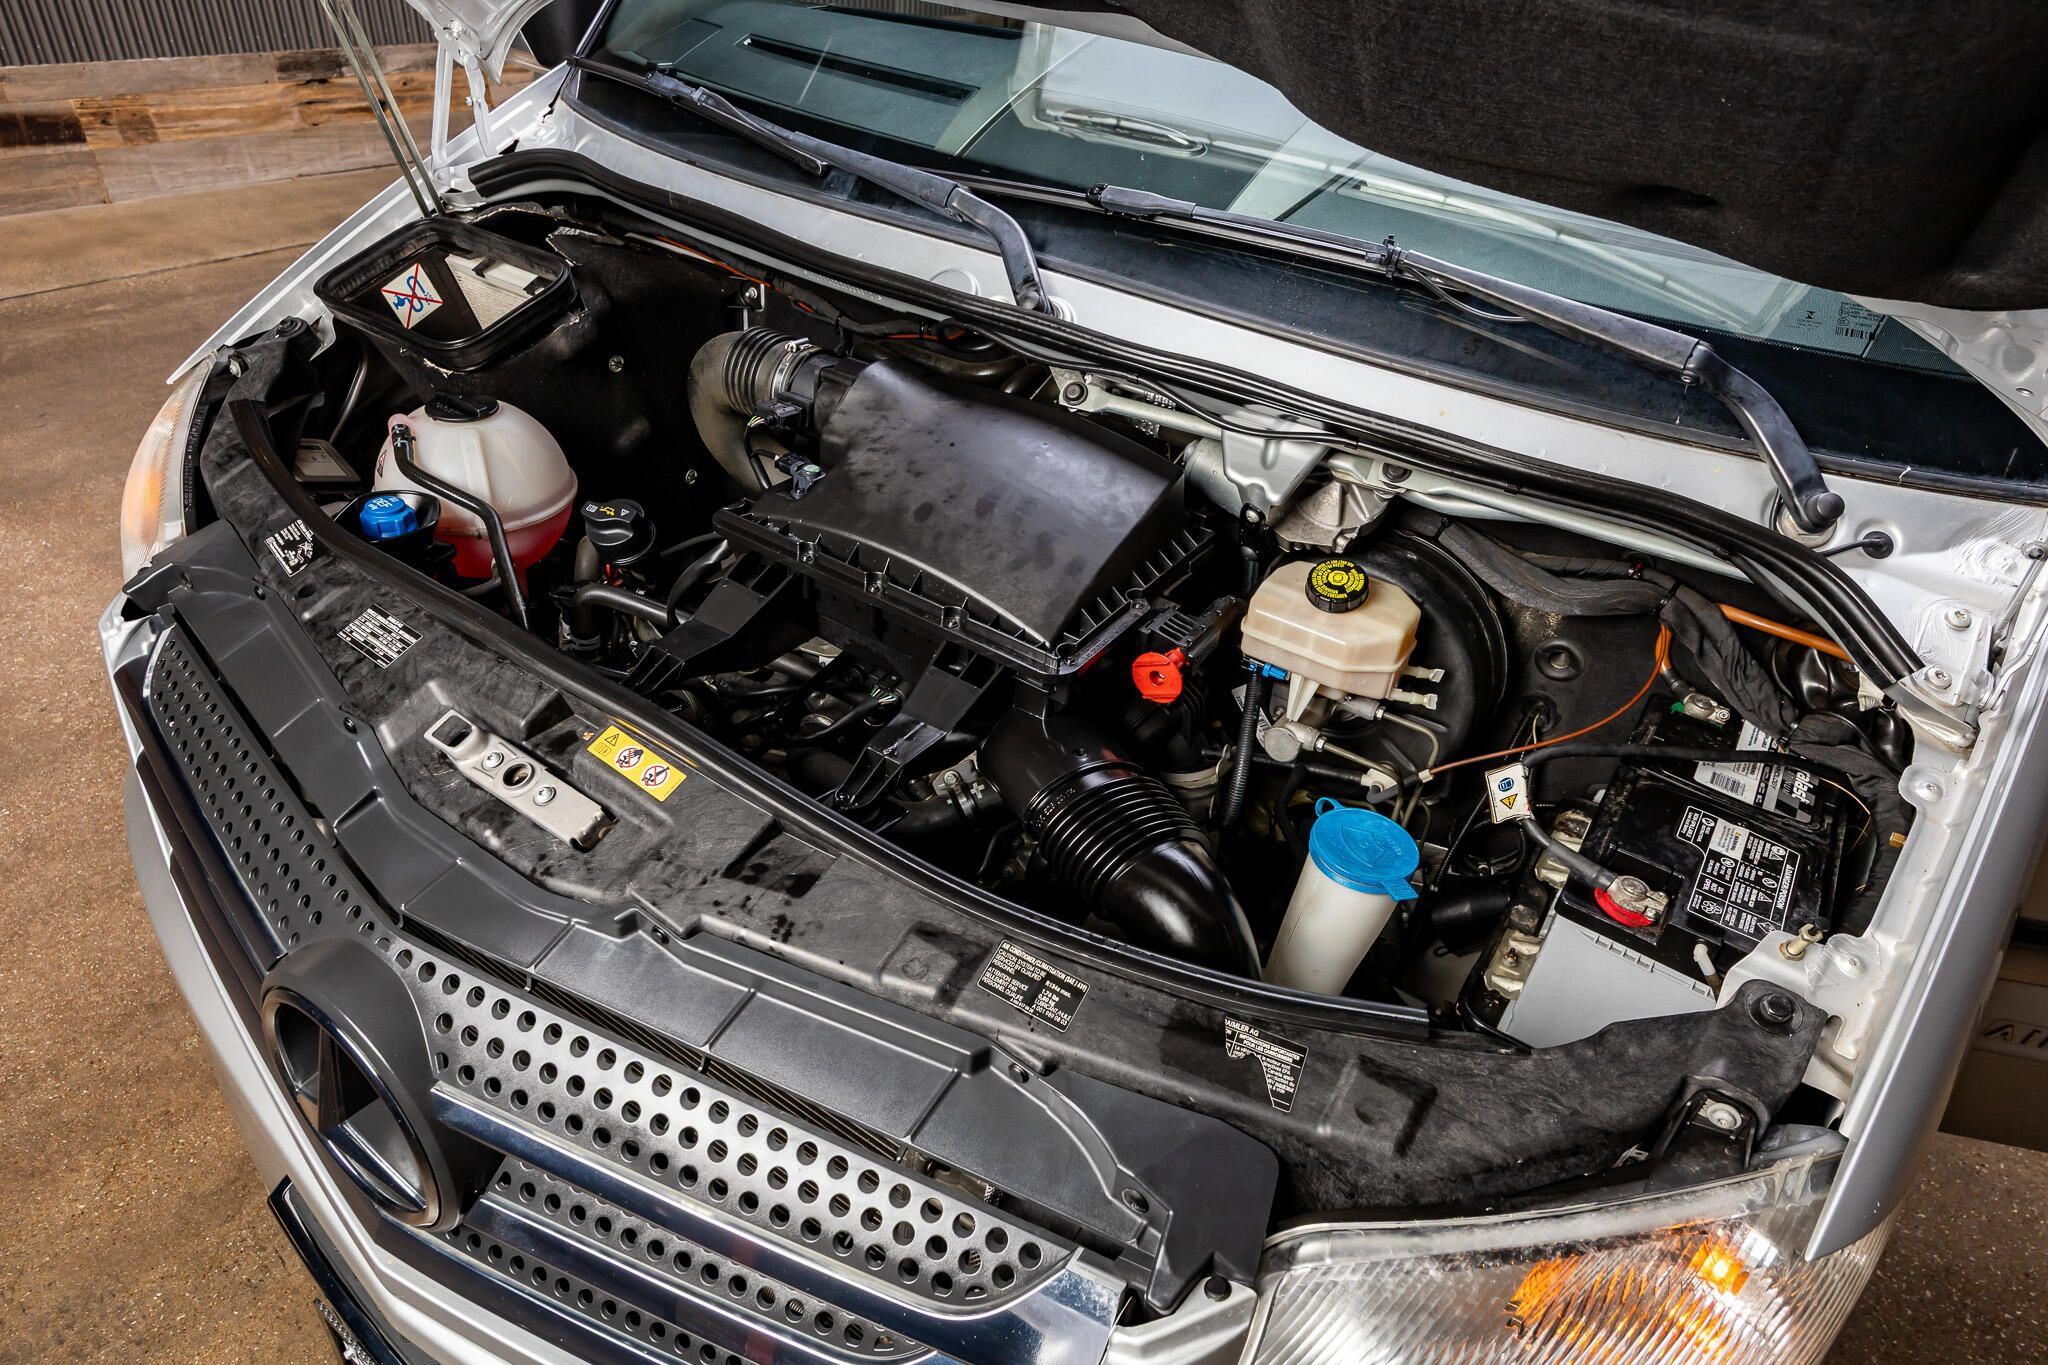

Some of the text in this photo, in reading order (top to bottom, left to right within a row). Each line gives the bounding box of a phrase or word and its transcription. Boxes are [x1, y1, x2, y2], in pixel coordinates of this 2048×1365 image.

[1017, 959, 1035, 971] SYSTEM
[1020, 967, 1042, 982] QUALIFIED
[1249, 1028, 1259, 1037] AG
